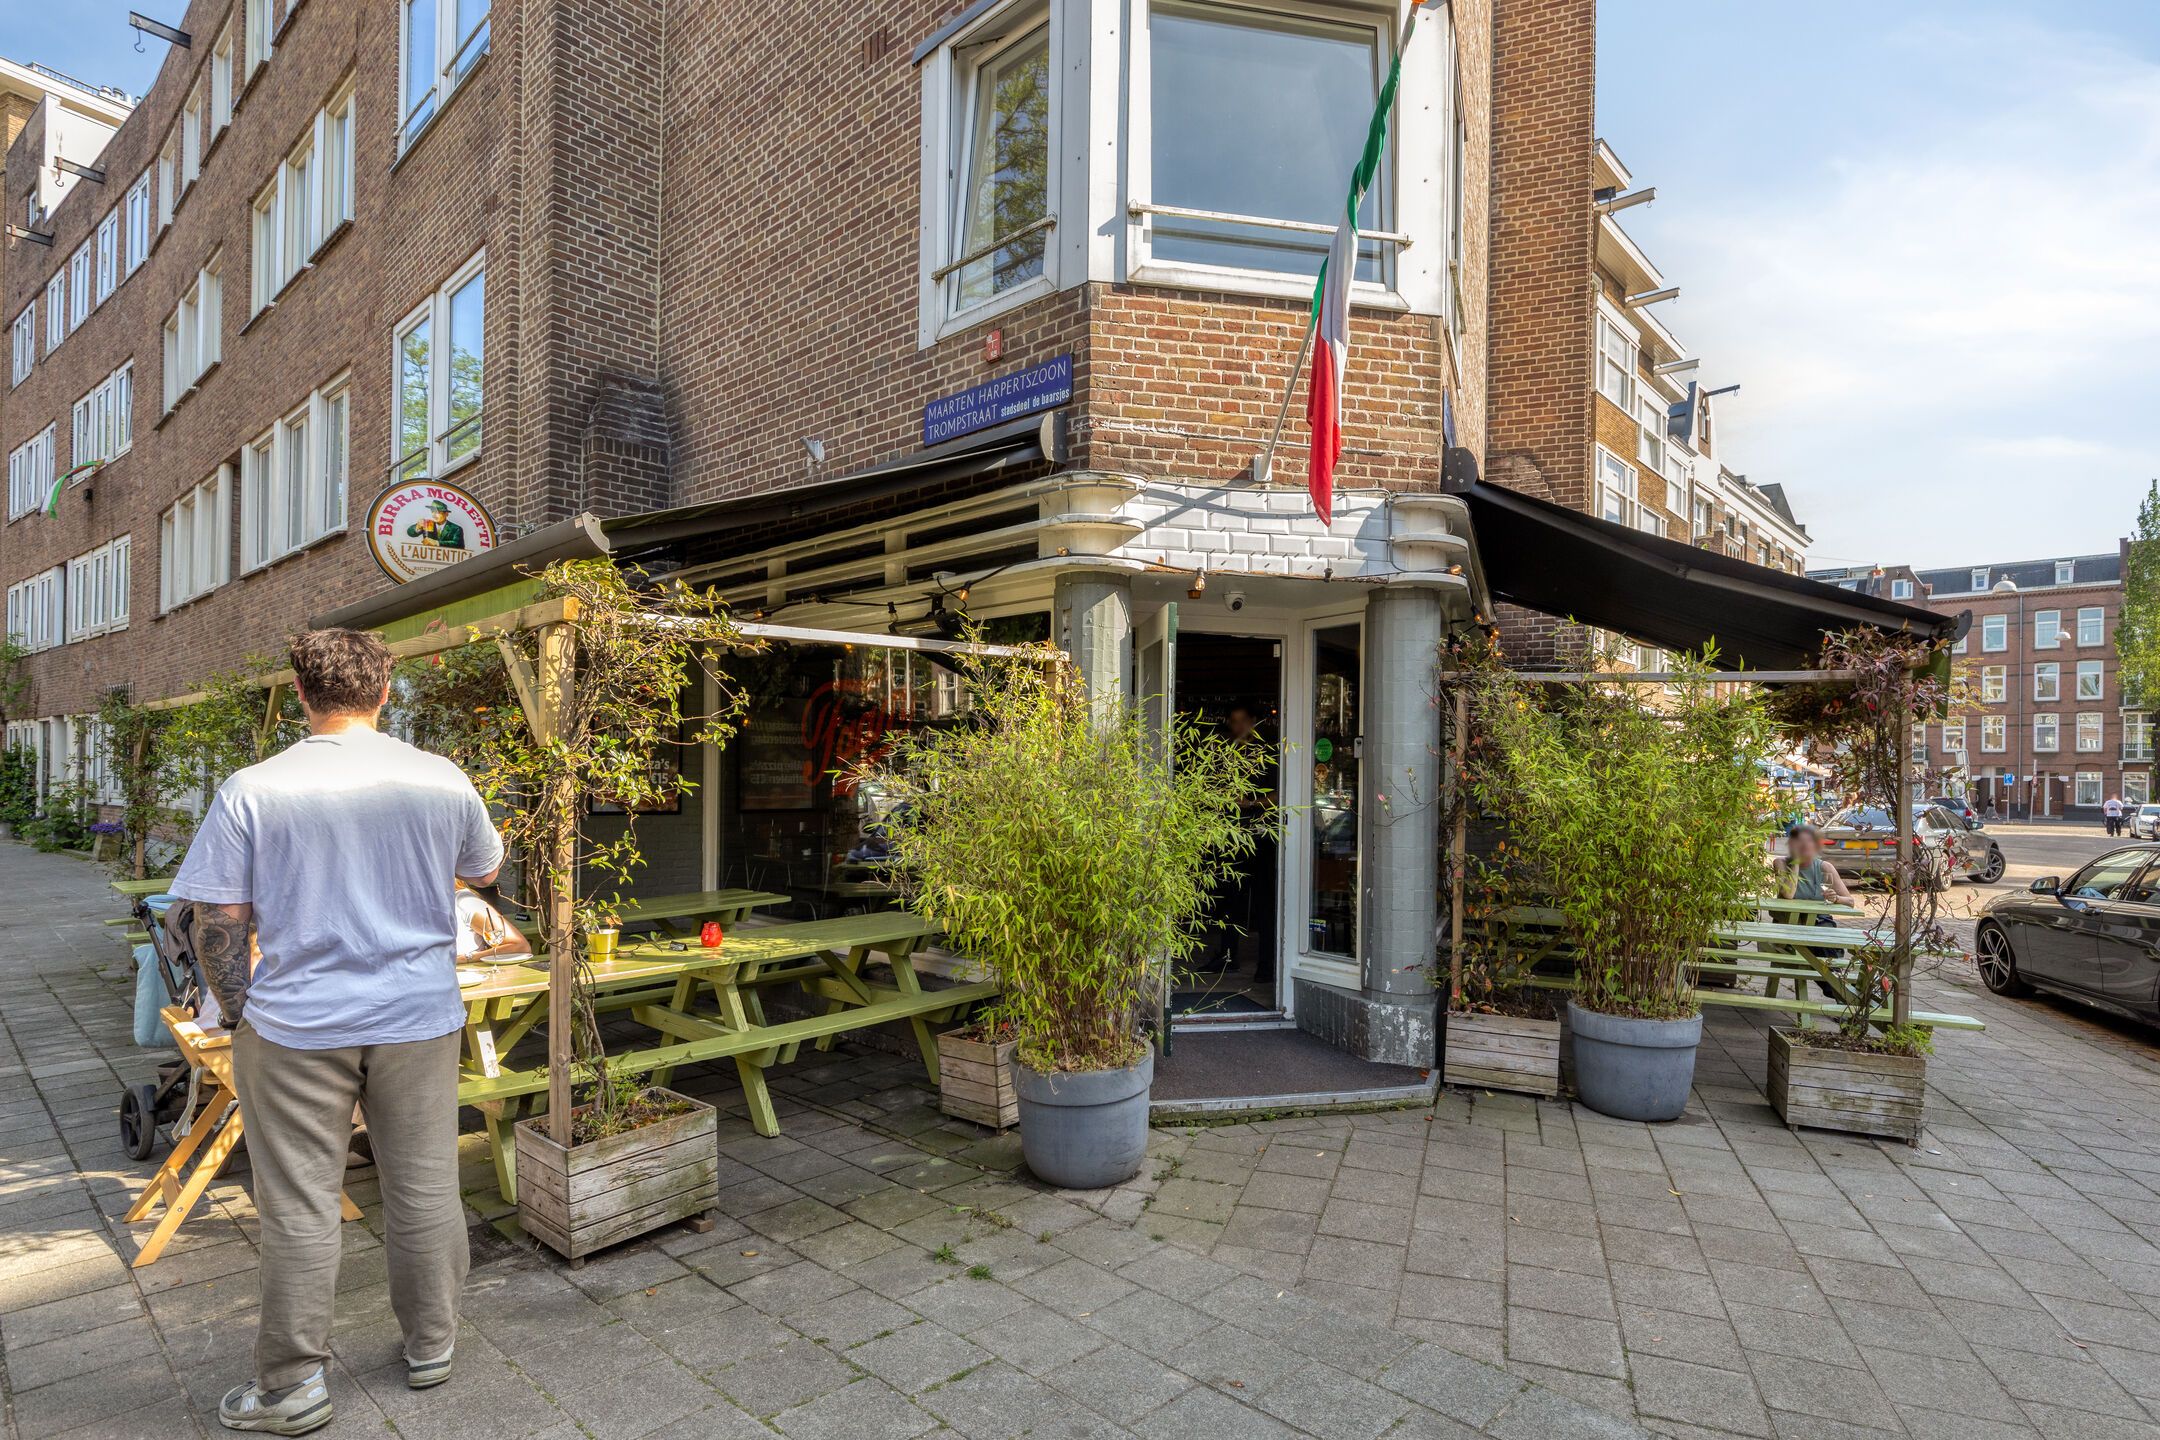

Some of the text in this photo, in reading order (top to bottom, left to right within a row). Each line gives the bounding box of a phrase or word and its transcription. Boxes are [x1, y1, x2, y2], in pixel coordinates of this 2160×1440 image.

[928, 361, 1066, 421] MAARTEN HARPERTSZOON
[1001, 388, 1070, 417] stadsdeel de baarsjes
[928, 404, 998, 439] TROMPSTRAAT
[379, 487, 490, 548] BIRRA MORETTI
[651, 772, 669, 785] €15
